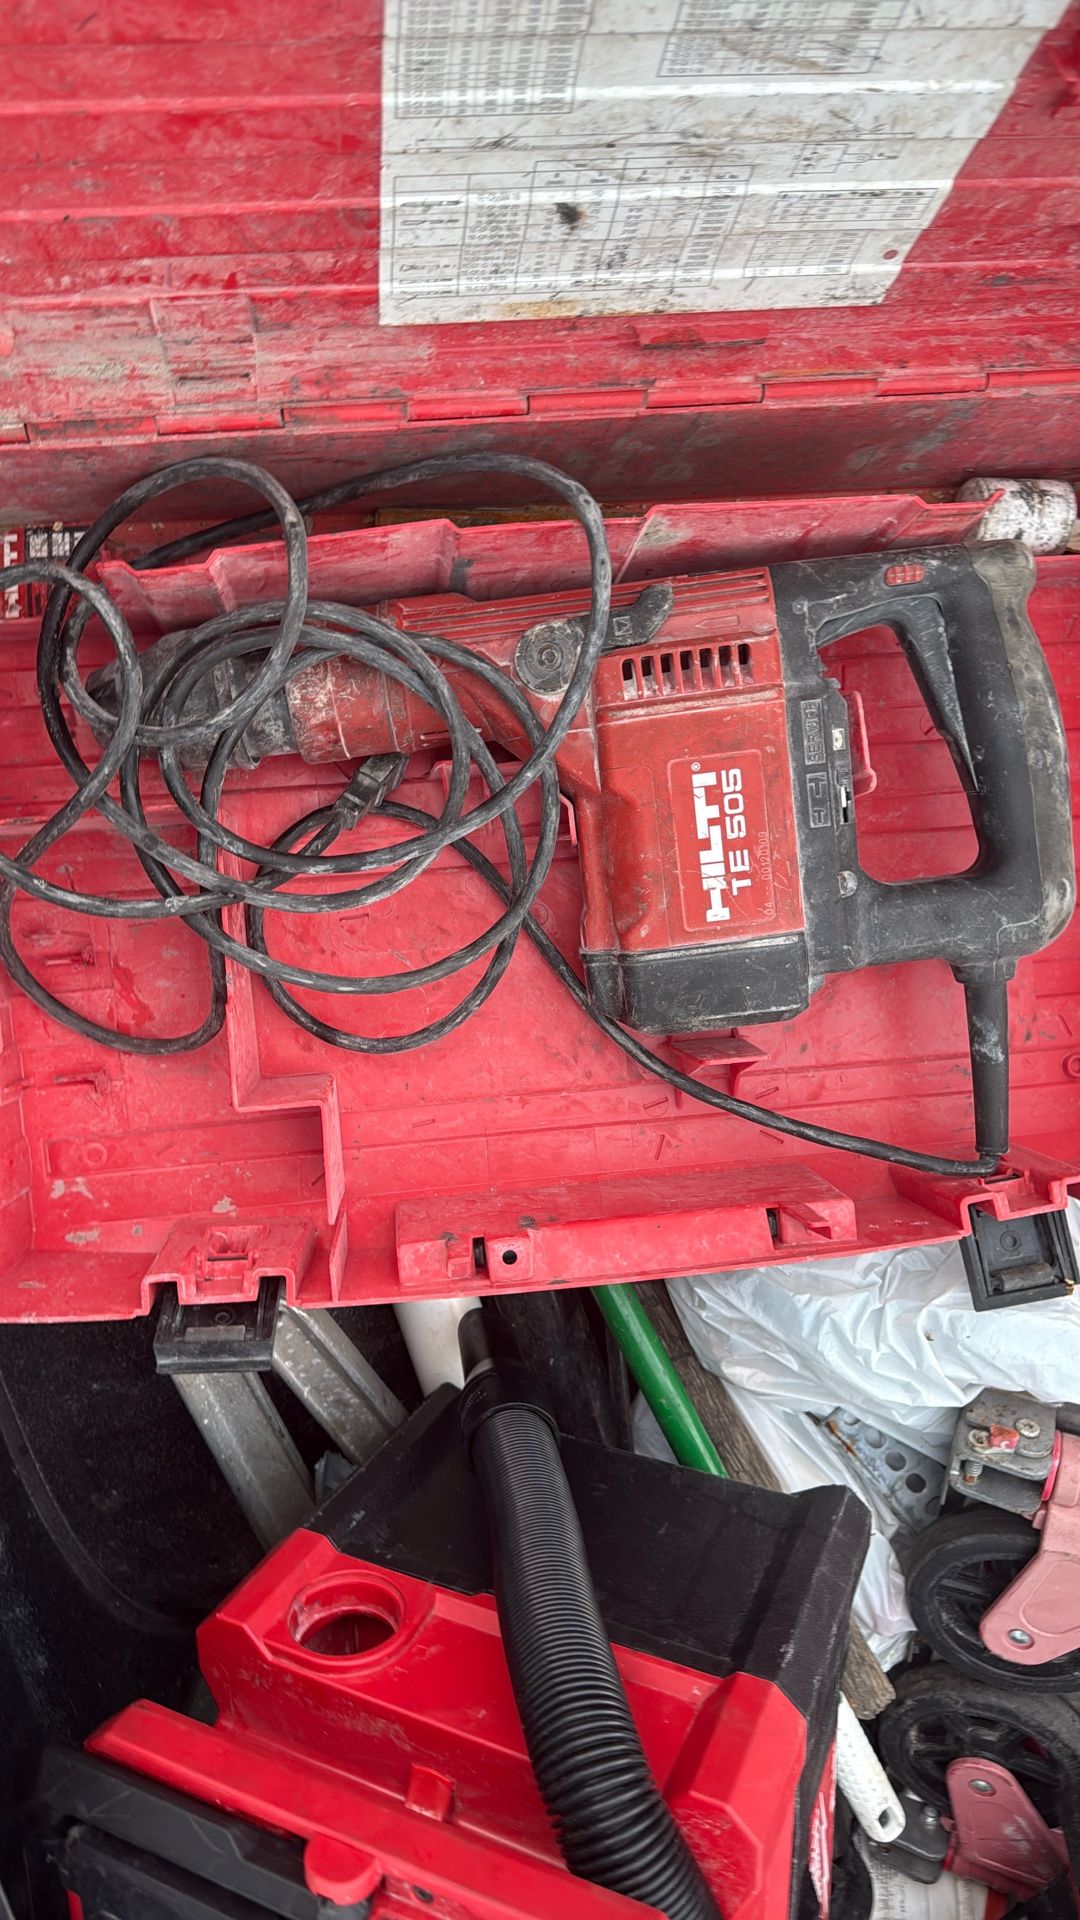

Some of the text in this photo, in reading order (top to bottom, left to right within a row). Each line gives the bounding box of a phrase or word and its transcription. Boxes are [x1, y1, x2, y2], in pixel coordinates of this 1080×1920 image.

[691, 771, 731, 923] HILTI
[721, 768, 752, 896] TE 505
